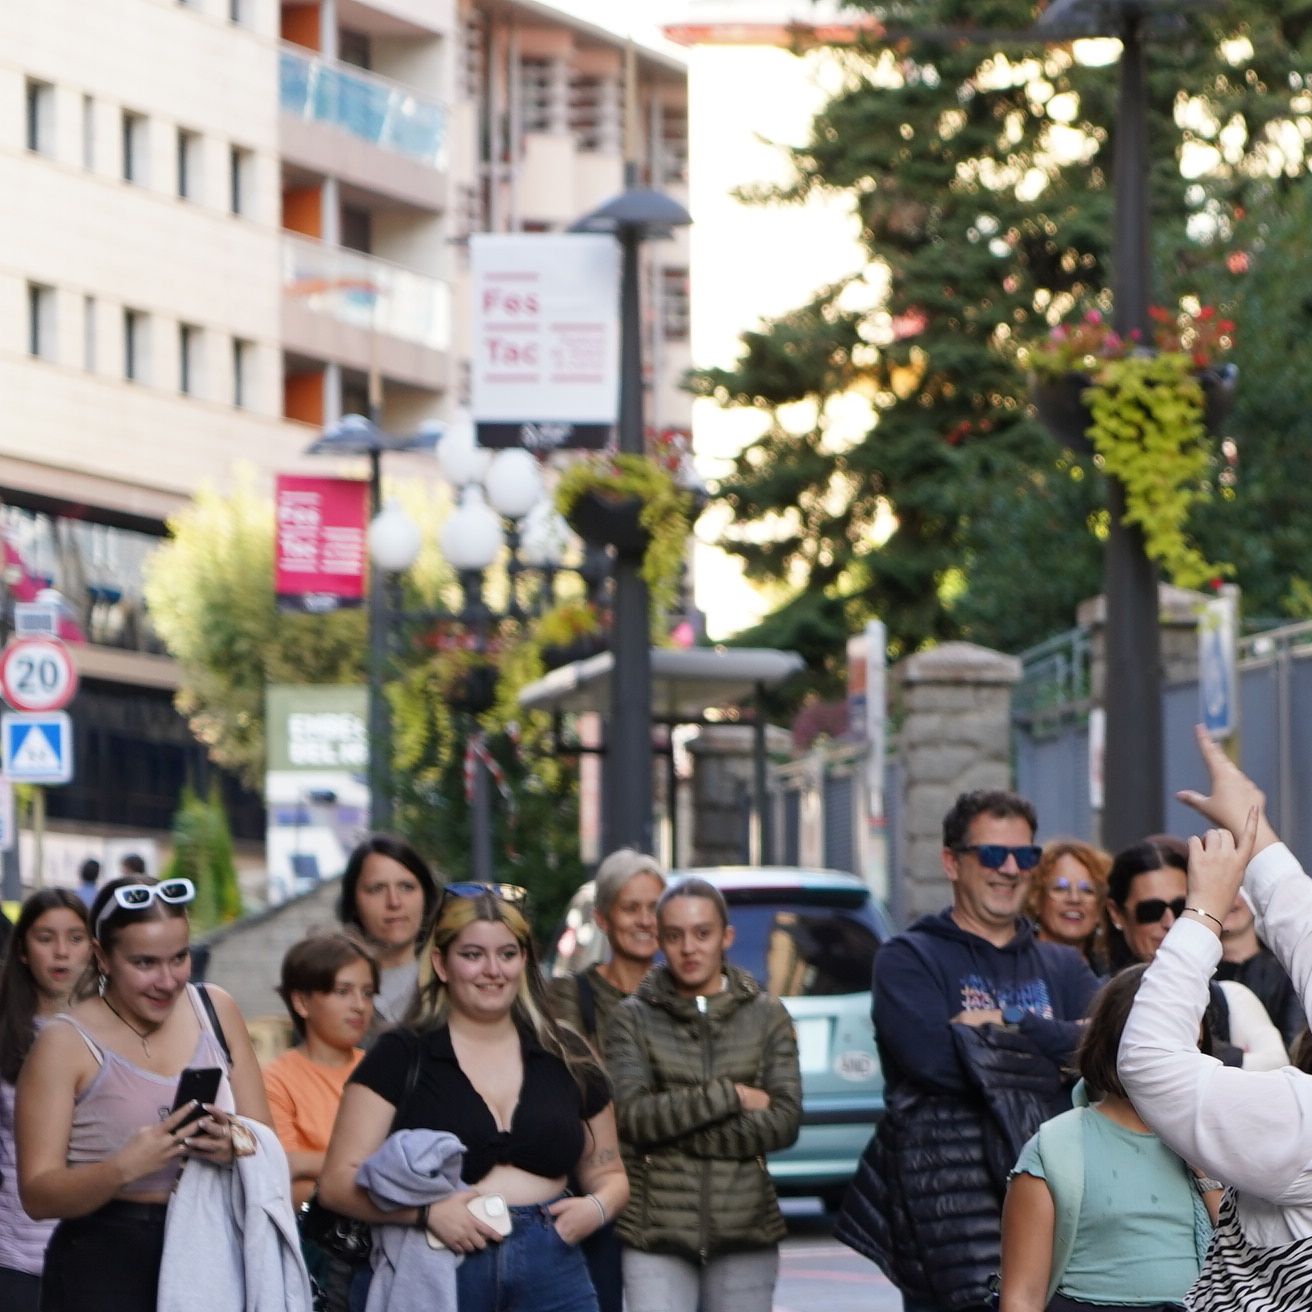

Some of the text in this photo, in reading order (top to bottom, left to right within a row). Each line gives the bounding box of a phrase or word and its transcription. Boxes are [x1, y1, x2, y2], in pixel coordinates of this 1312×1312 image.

[483, 289, 540, 315] Fes
[486, 338, 540, 364] Tac
[16, 656, 59, 693] 20
